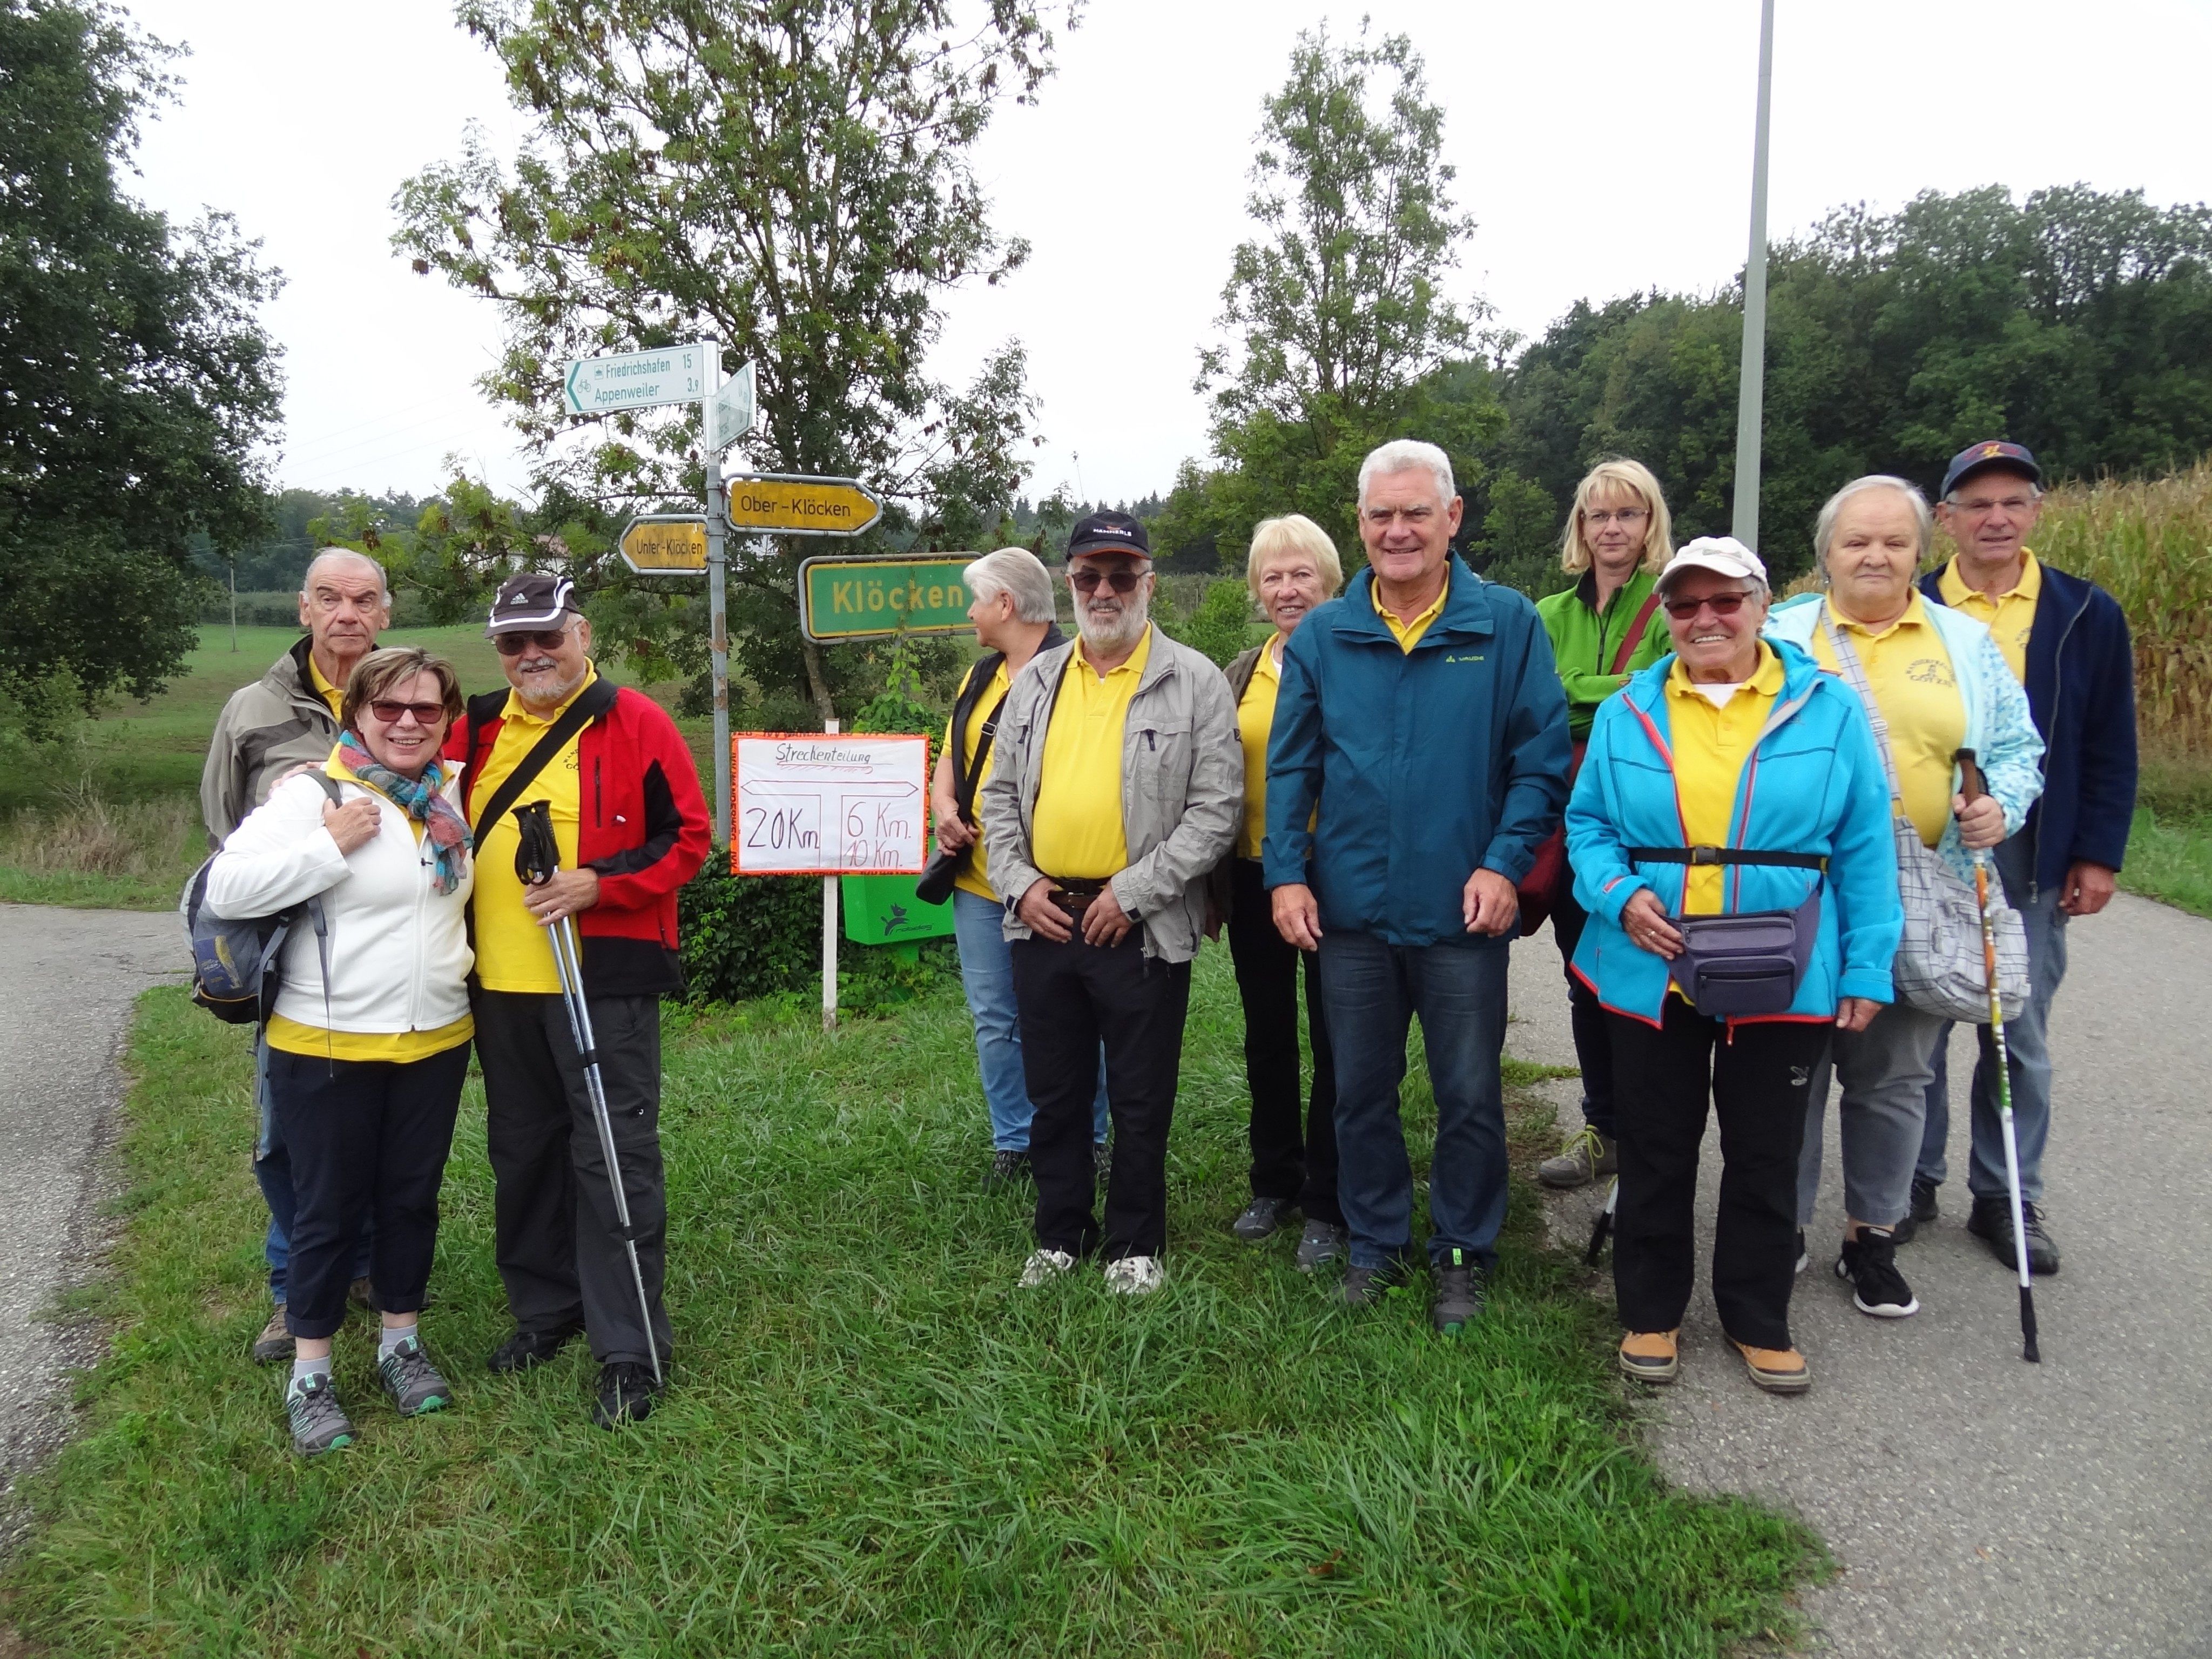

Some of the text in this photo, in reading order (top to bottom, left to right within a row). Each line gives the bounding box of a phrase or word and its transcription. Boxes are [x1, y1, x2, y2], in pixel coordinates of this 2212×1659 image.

[606, 354, 692, 379] Friedrichshafen 15
[595, 383, 660, 406] Appenweiler
[832, 579, 963, 613] Klöcken
[775, 743, 871, 765] Streckenteilung
[847, 801, 867, 837] 6
[843, 839, 868, 867] 10
